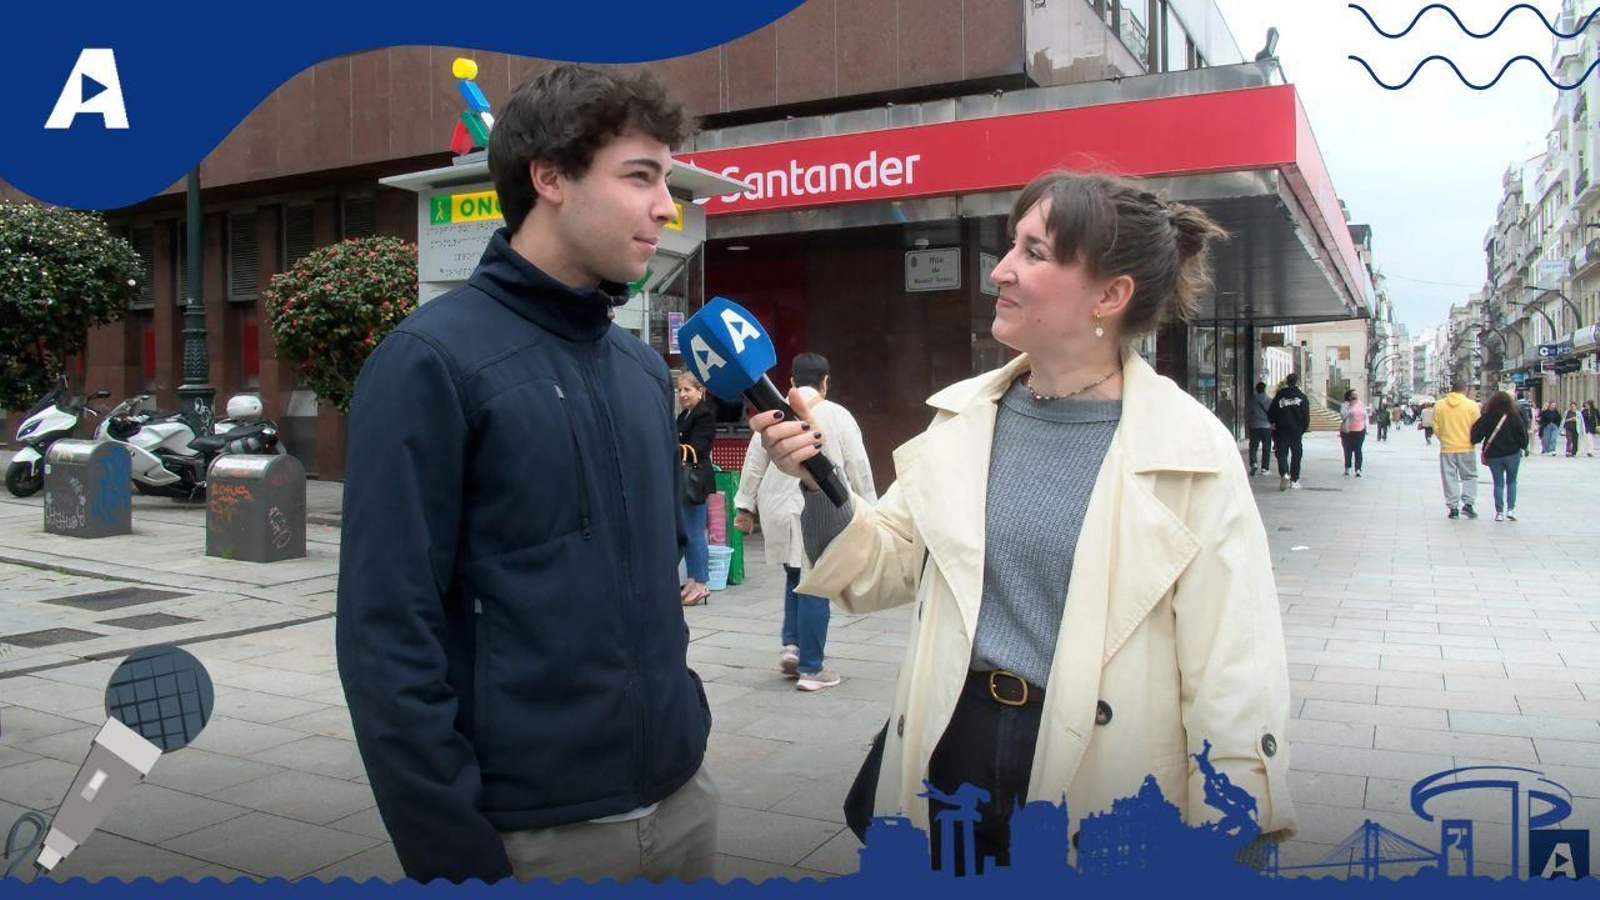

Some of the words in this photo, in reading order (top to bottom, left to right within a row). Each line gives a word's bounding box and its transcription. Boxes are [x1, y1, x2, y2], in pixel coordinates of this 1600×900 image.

[720, 150, 921, 203] Santander
[720, 308, 761, 354] A
[690, 334, 728, 383] A
